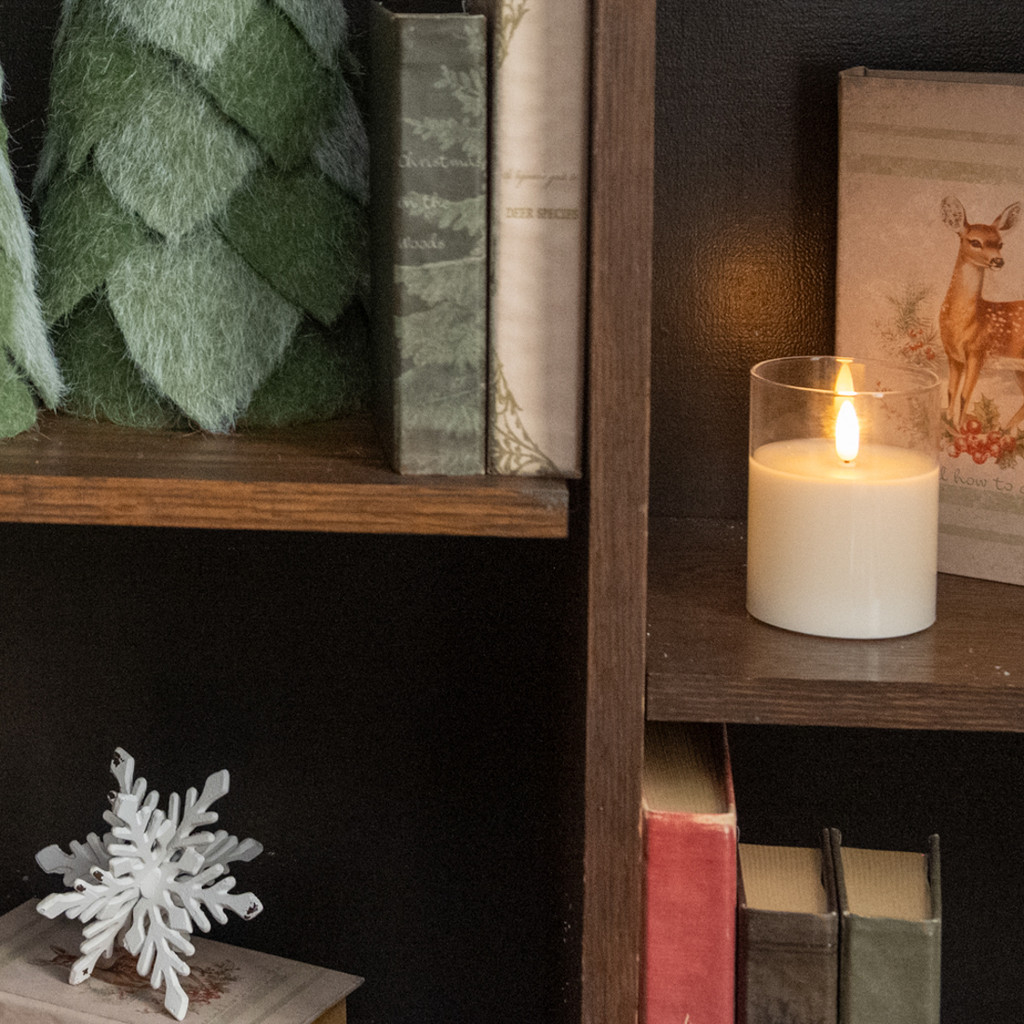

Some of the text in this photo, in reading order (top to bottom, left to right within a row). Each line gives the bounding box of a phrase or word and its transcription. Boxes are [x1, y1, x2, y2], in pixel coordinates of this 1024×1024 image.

[506, 207, 578, 220] DEER SPECIES
[954, 468, 987, 488] how
[993, 477, 1014, 492] to
